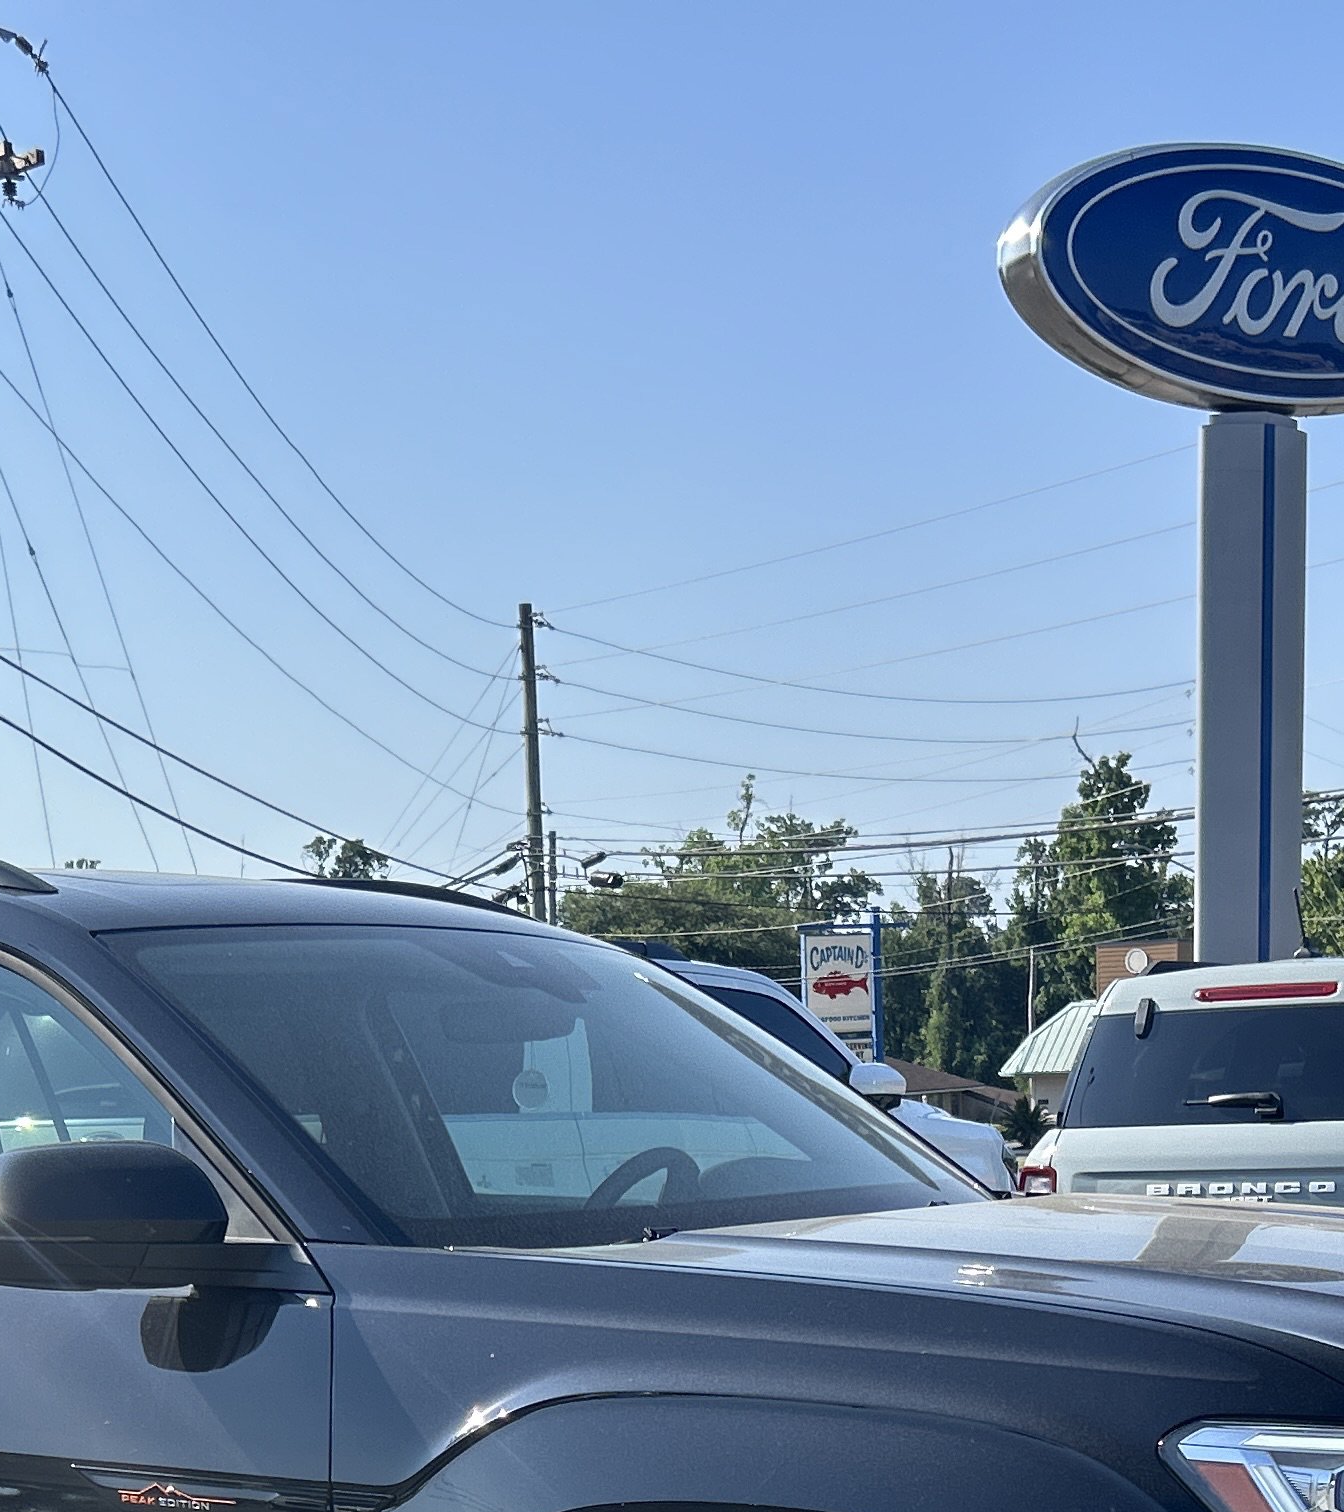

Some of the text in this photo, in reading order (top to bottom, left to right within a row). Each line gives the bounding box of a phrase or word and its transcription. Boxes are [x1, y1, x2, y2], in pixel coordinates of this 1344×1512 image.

[810, 945, 854, 971] CAPTAIN
[1146, 1181, 1336, 1197] BRONCO
[121, 1494, 210, 1511] PEAK EDITION
